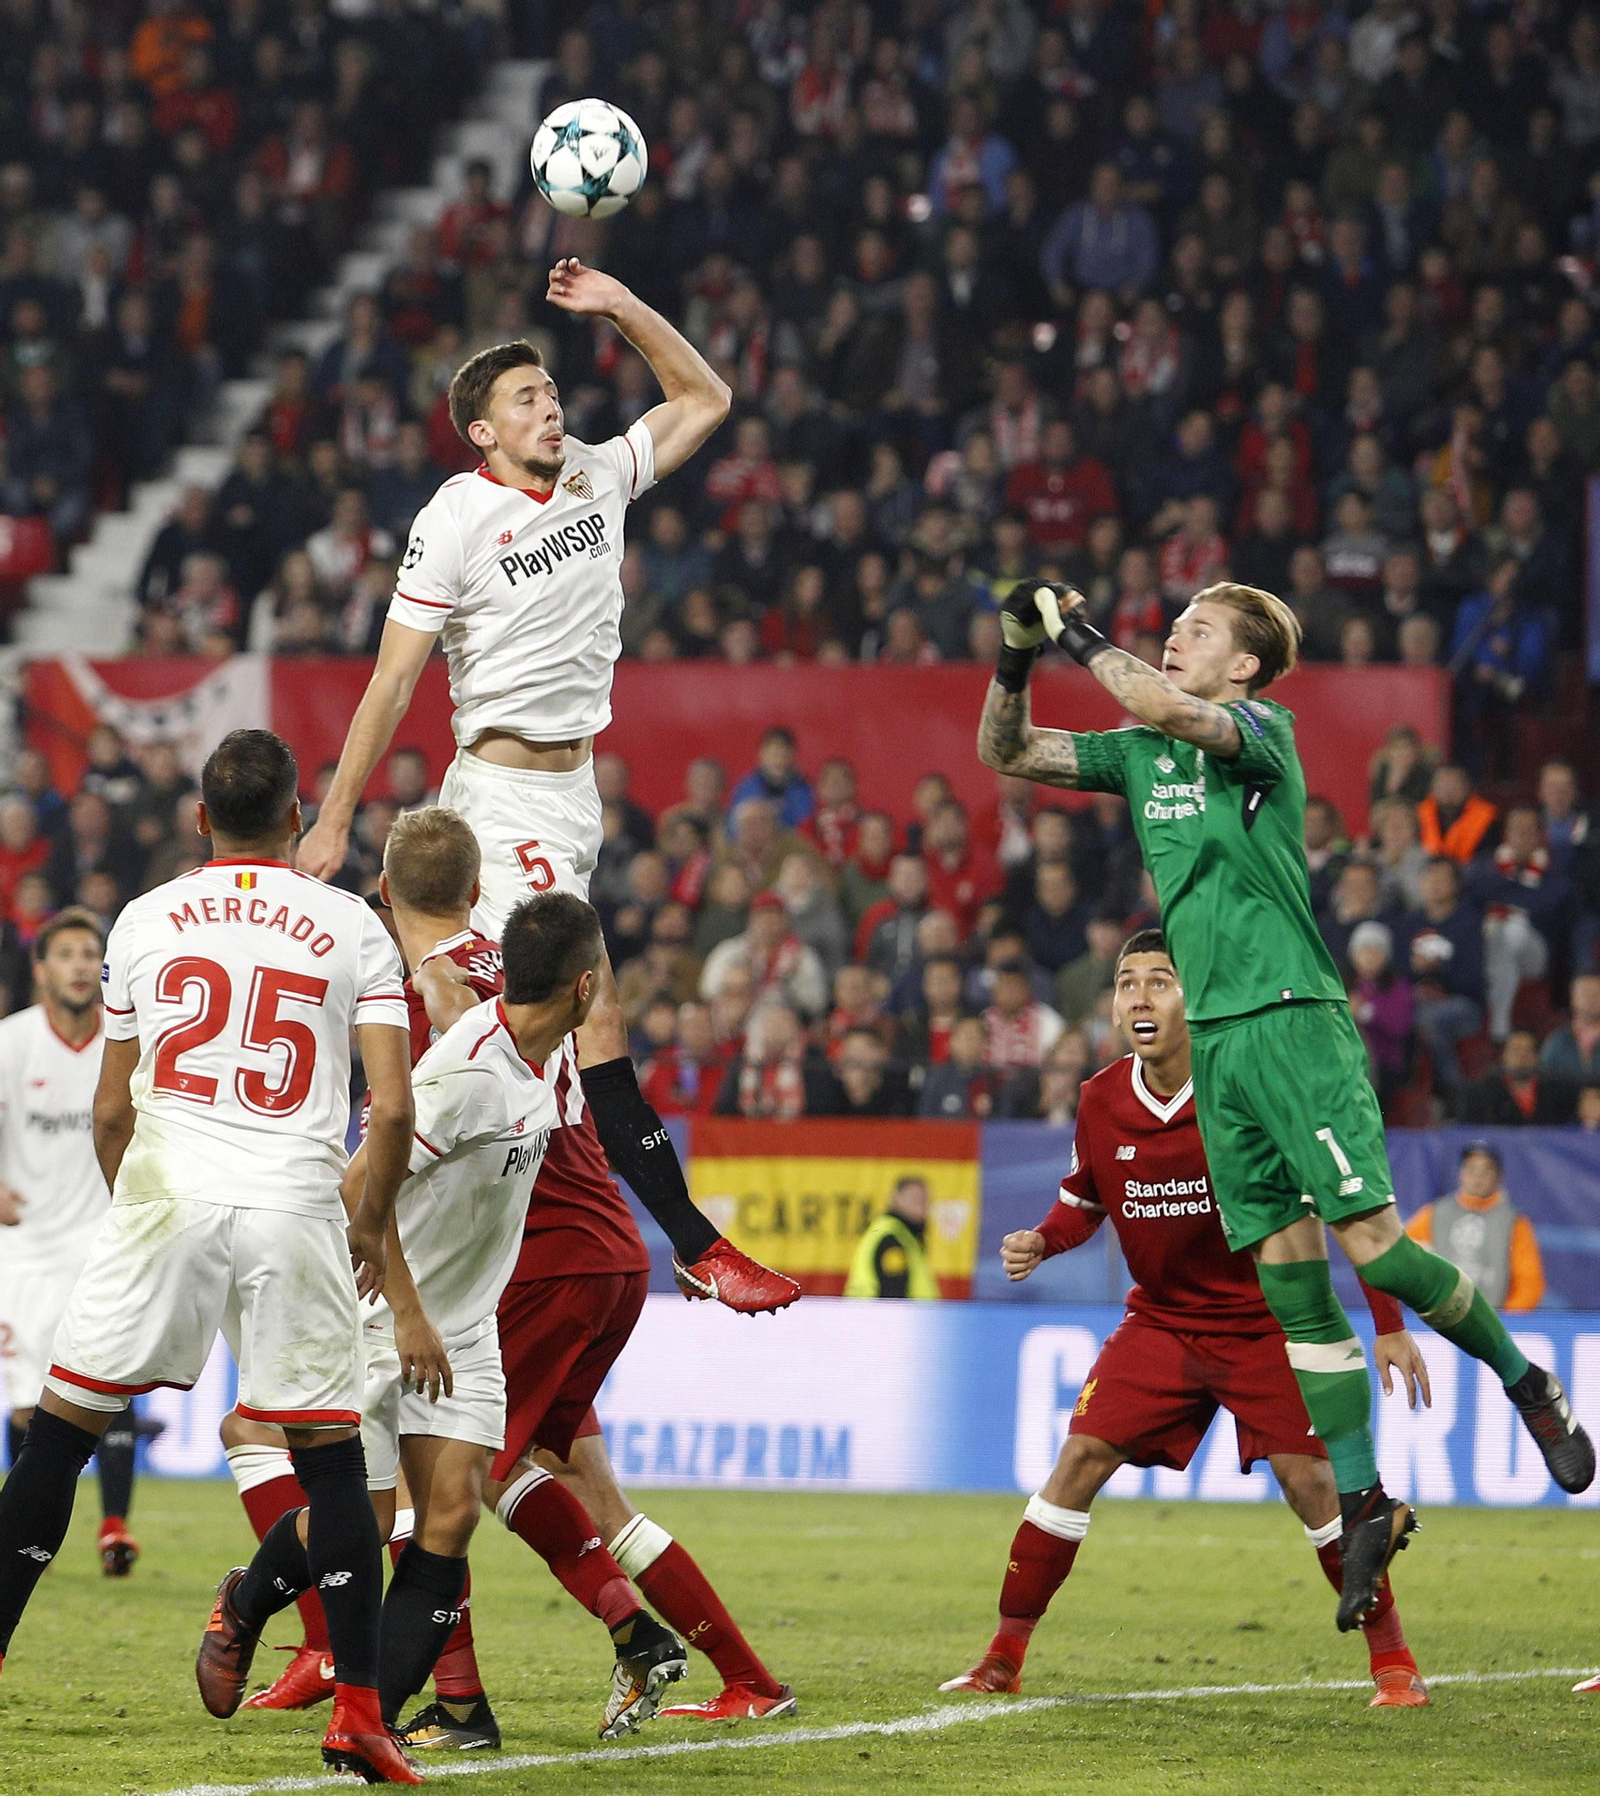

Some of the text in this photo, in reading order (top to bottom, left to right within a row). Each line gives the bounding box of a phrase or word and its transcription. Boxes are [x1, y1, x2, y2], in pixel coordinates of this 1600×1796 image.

[498, 512, 606, 587] PlayWSOP
[588, 541, 612, 560] .com
[512, 840, 557, 895] 5
[167, 897, 336, 958] MERCADO
[152, 955, 331, 1119] 25
[641, 1127, 669, 1150] SFC
[1314, 1126, 1354, 1177] 1
[1121, 1195, 1212, 1219] Chartered
[1124, 1175, 1208, 1198] Standard
[622, 1419, 851, 1480] GAZPROM
